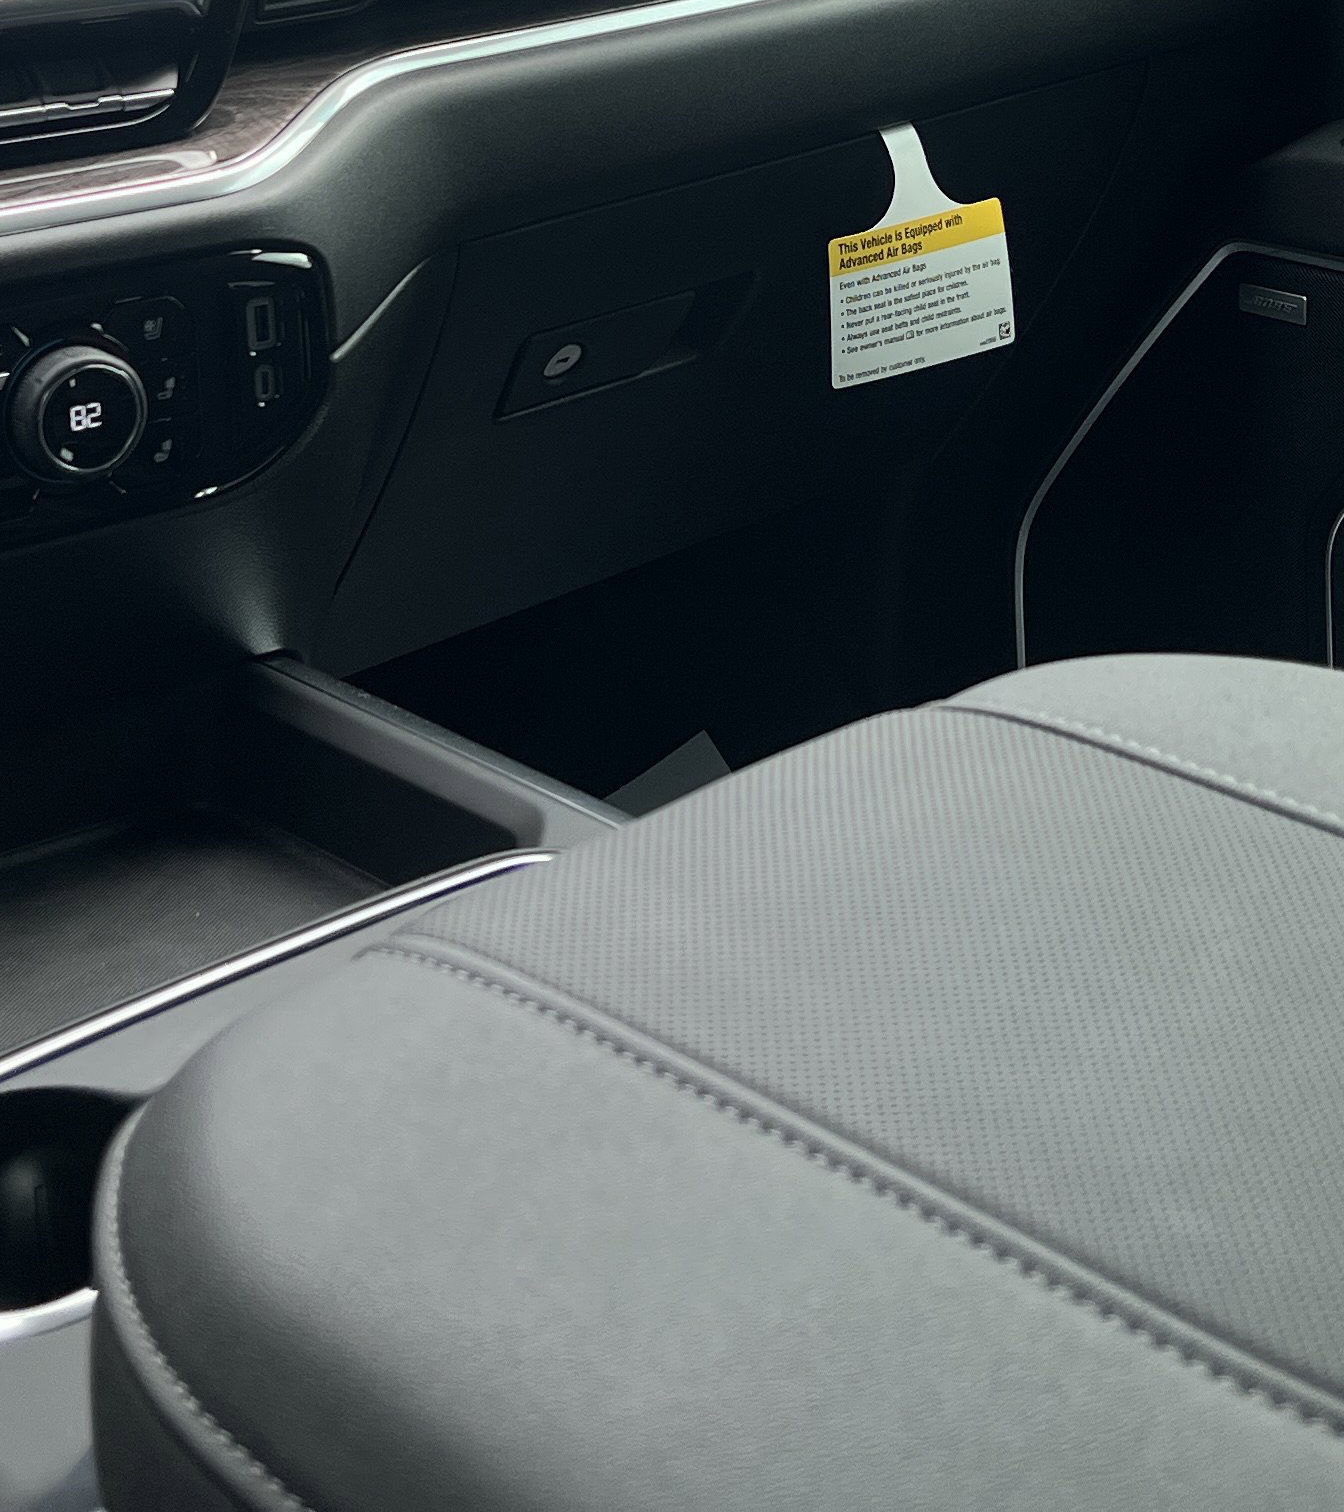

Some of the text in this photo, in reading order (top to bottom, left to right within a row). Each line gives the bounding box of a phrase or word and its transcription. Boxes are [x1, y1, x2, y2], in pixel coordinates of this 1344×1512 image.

[838, 241, 858, 256] This
[860, 232, 893, 250] Vehicle
[904, 219, 943, 240] Equipped
[944, 214, 963, 229] with
[839, 240, 923, 270] Advanced Air Bags
[839, 262, 927, 291] Even with Advanced Air Bags
[69, 402, 103, 431] 82
